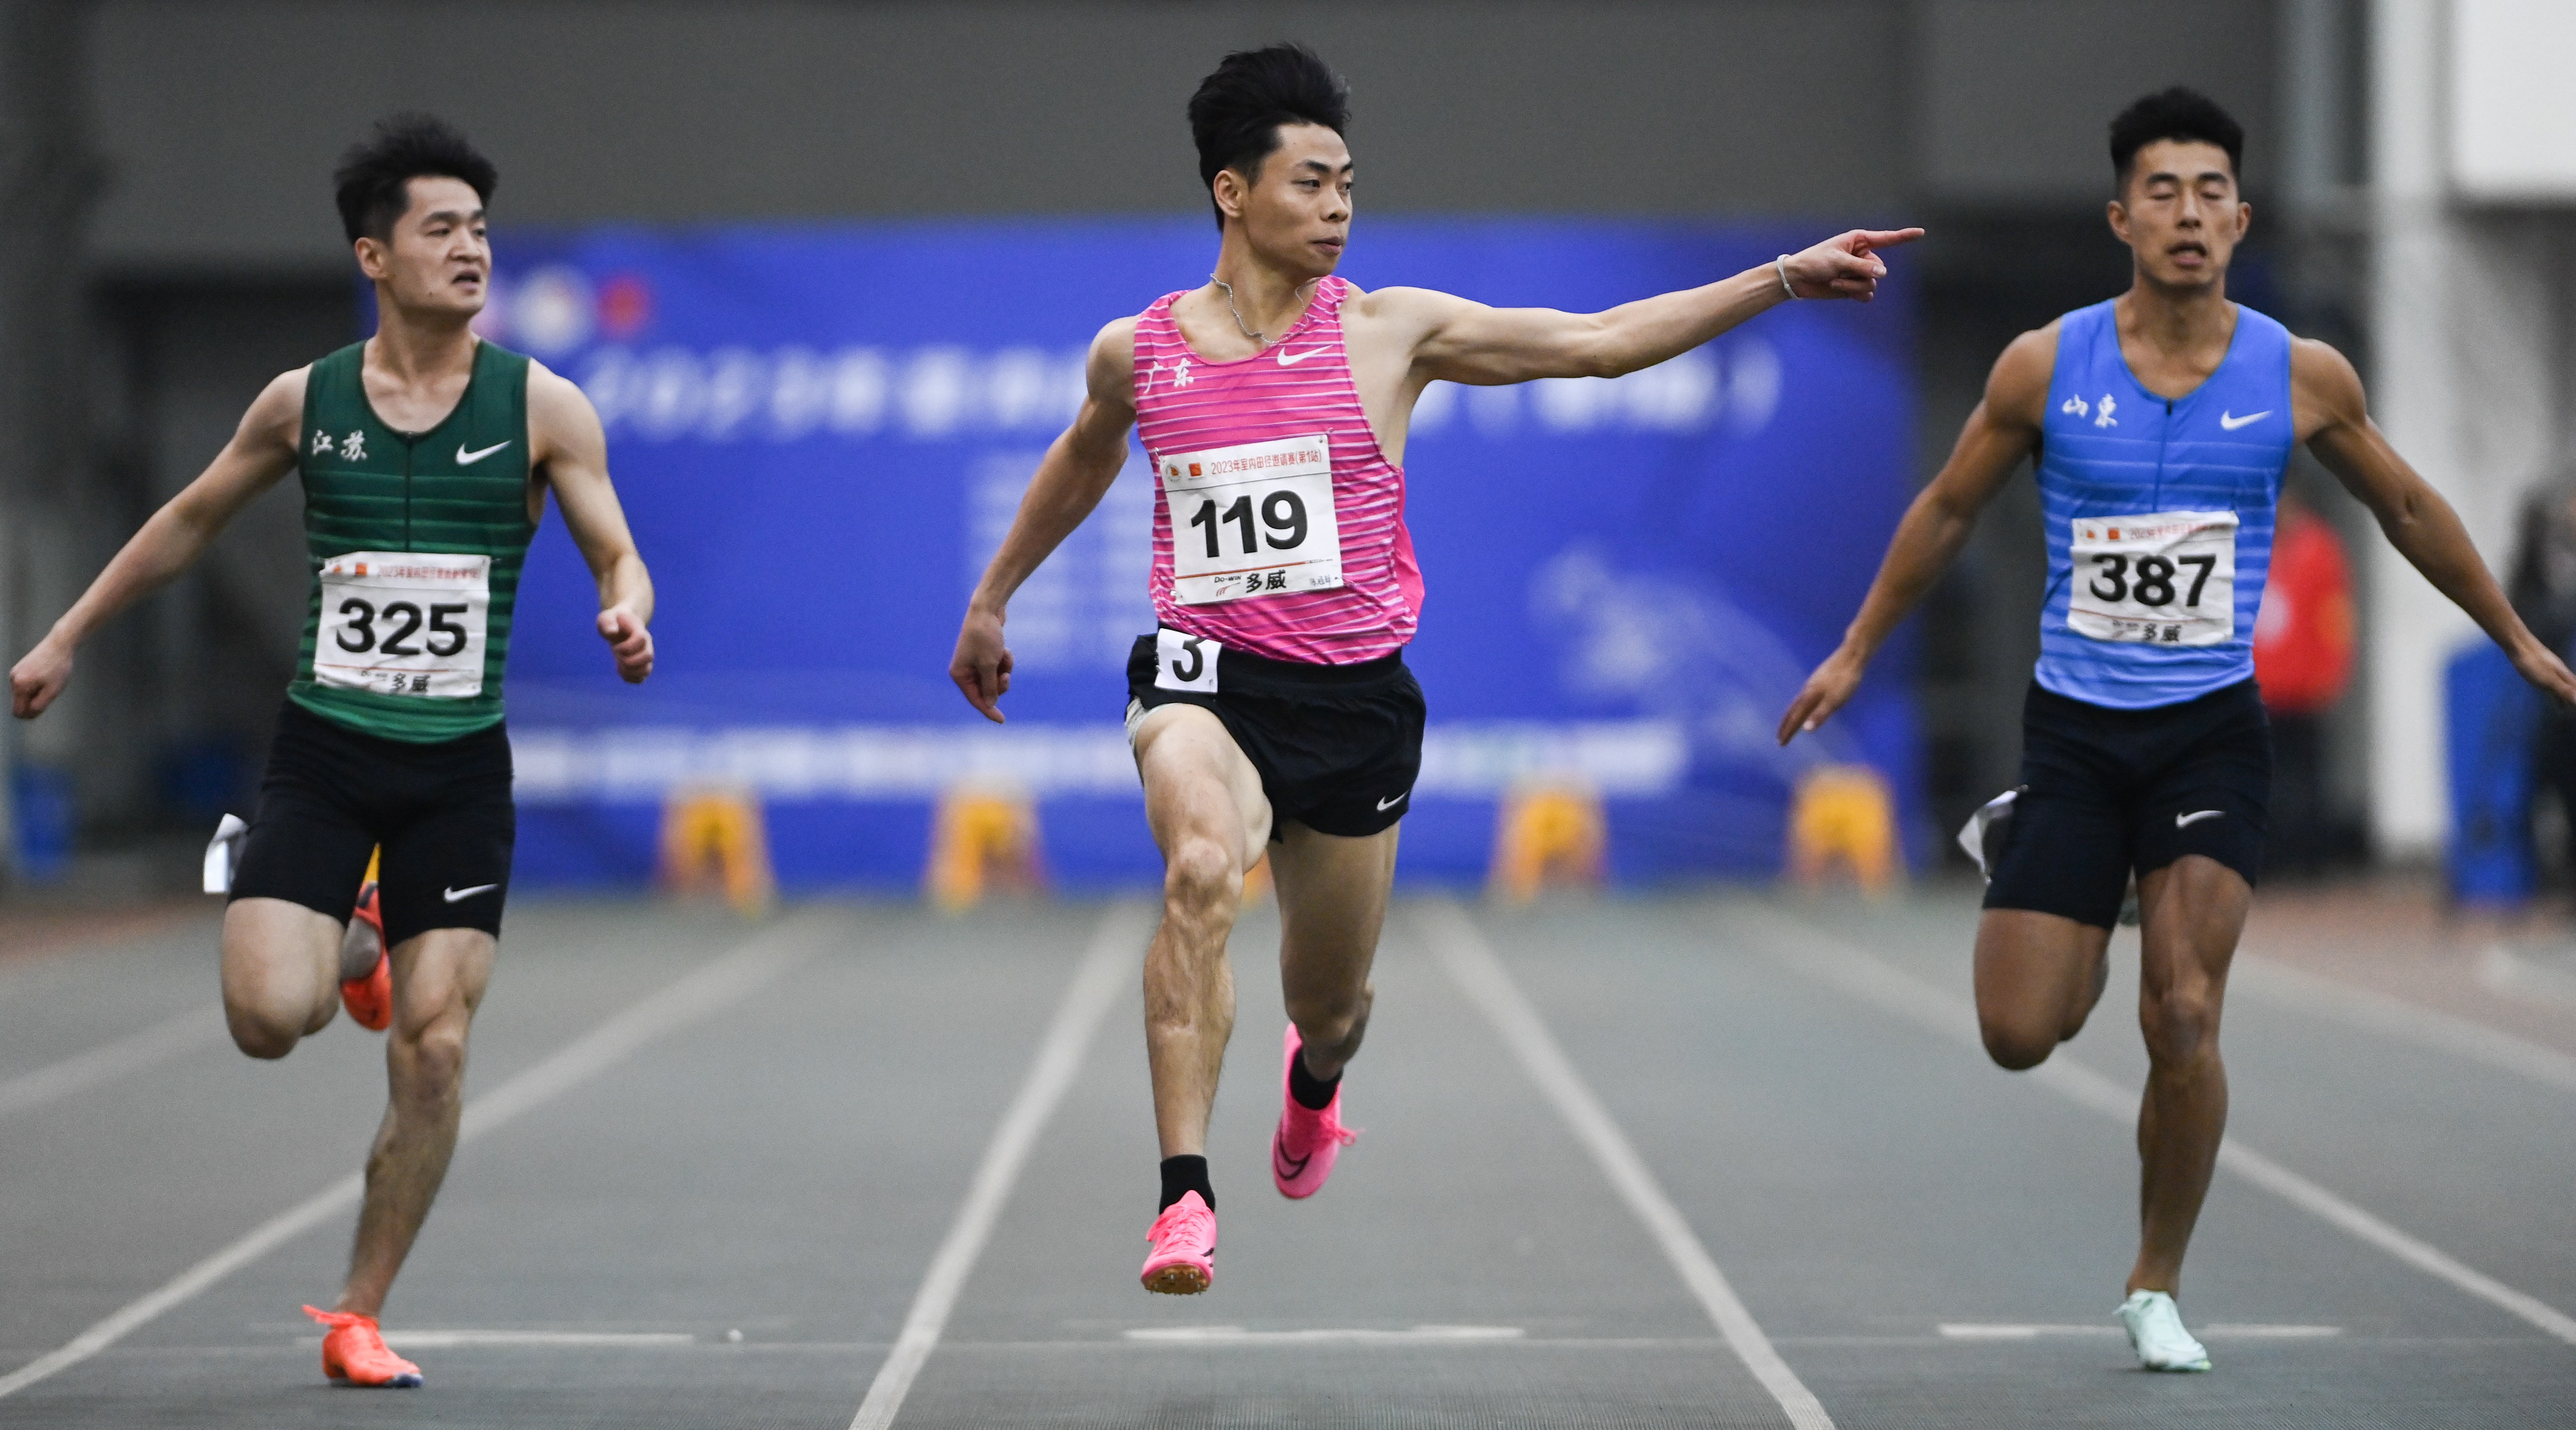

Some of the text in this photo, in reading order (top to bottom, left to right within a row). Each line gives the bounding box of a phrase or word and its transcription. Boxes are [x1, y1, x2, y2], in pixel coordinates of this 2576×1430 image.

[1191, 490, 1307, 558] 119
[1246, 570, 1287, 594] 多威
[2089, 553, 2216, 607] 387
[336, 597, 469, 657] 325
[1172, 636, 1207, 682] 3
